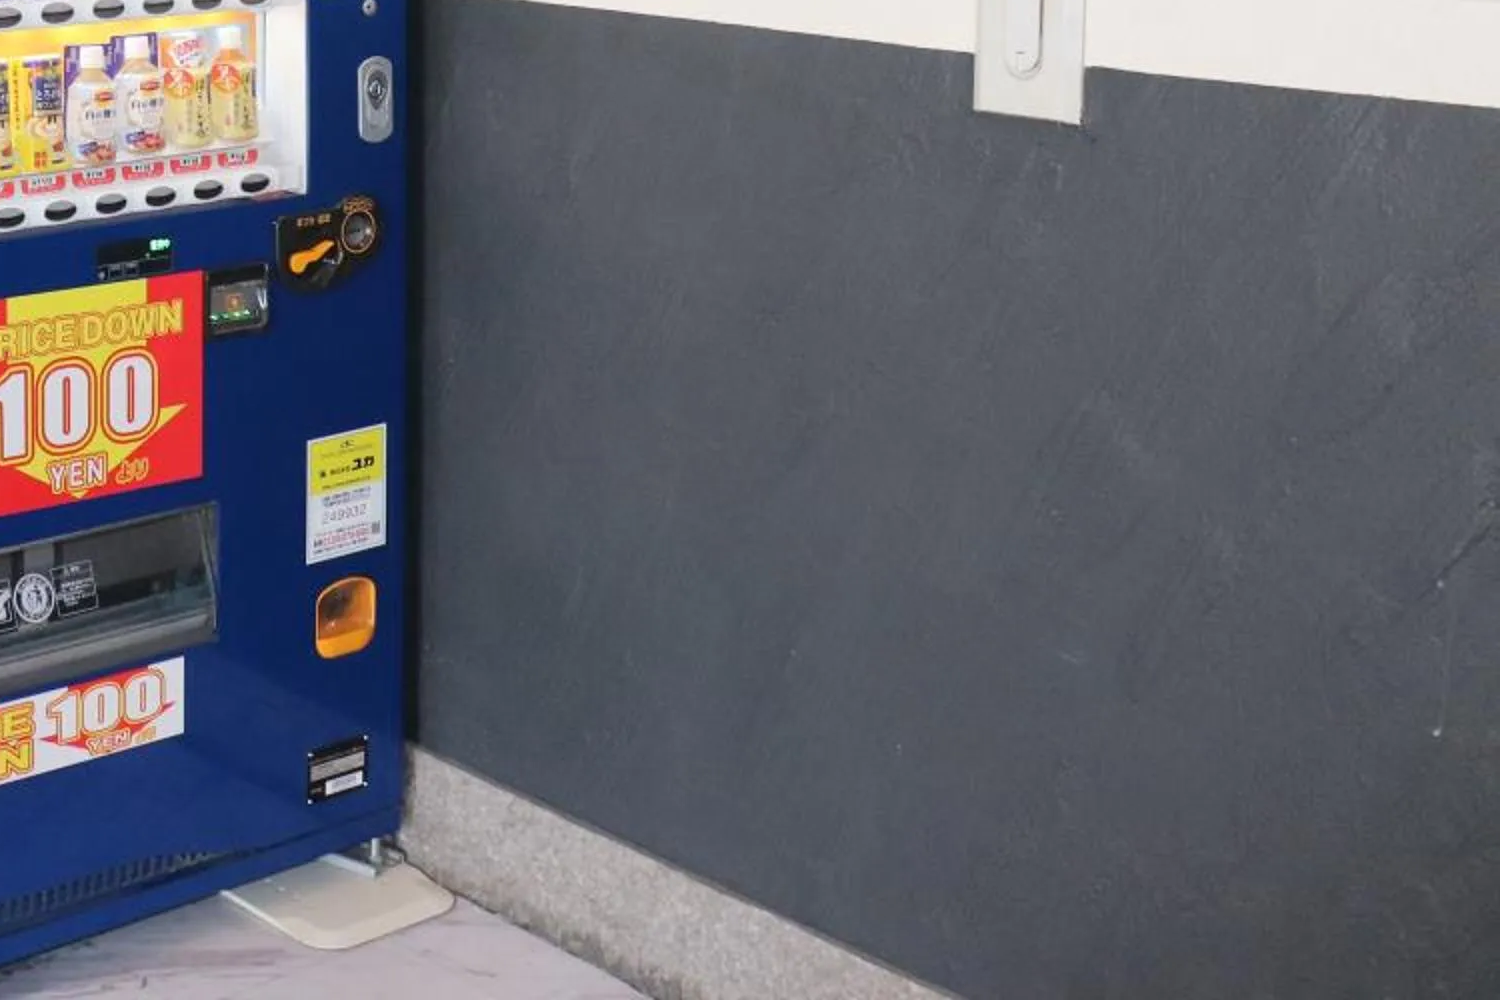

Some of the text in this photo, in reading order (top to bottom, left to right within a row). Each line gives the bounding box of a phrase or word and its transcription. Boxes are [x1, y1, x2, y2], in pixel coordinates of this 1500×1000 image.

[81, 298, 185, 347] DOWN
[45, 454, 108, 495] YEN
[46, 665, 170, 747] 100
[85, 729, 131, 758] YEN
